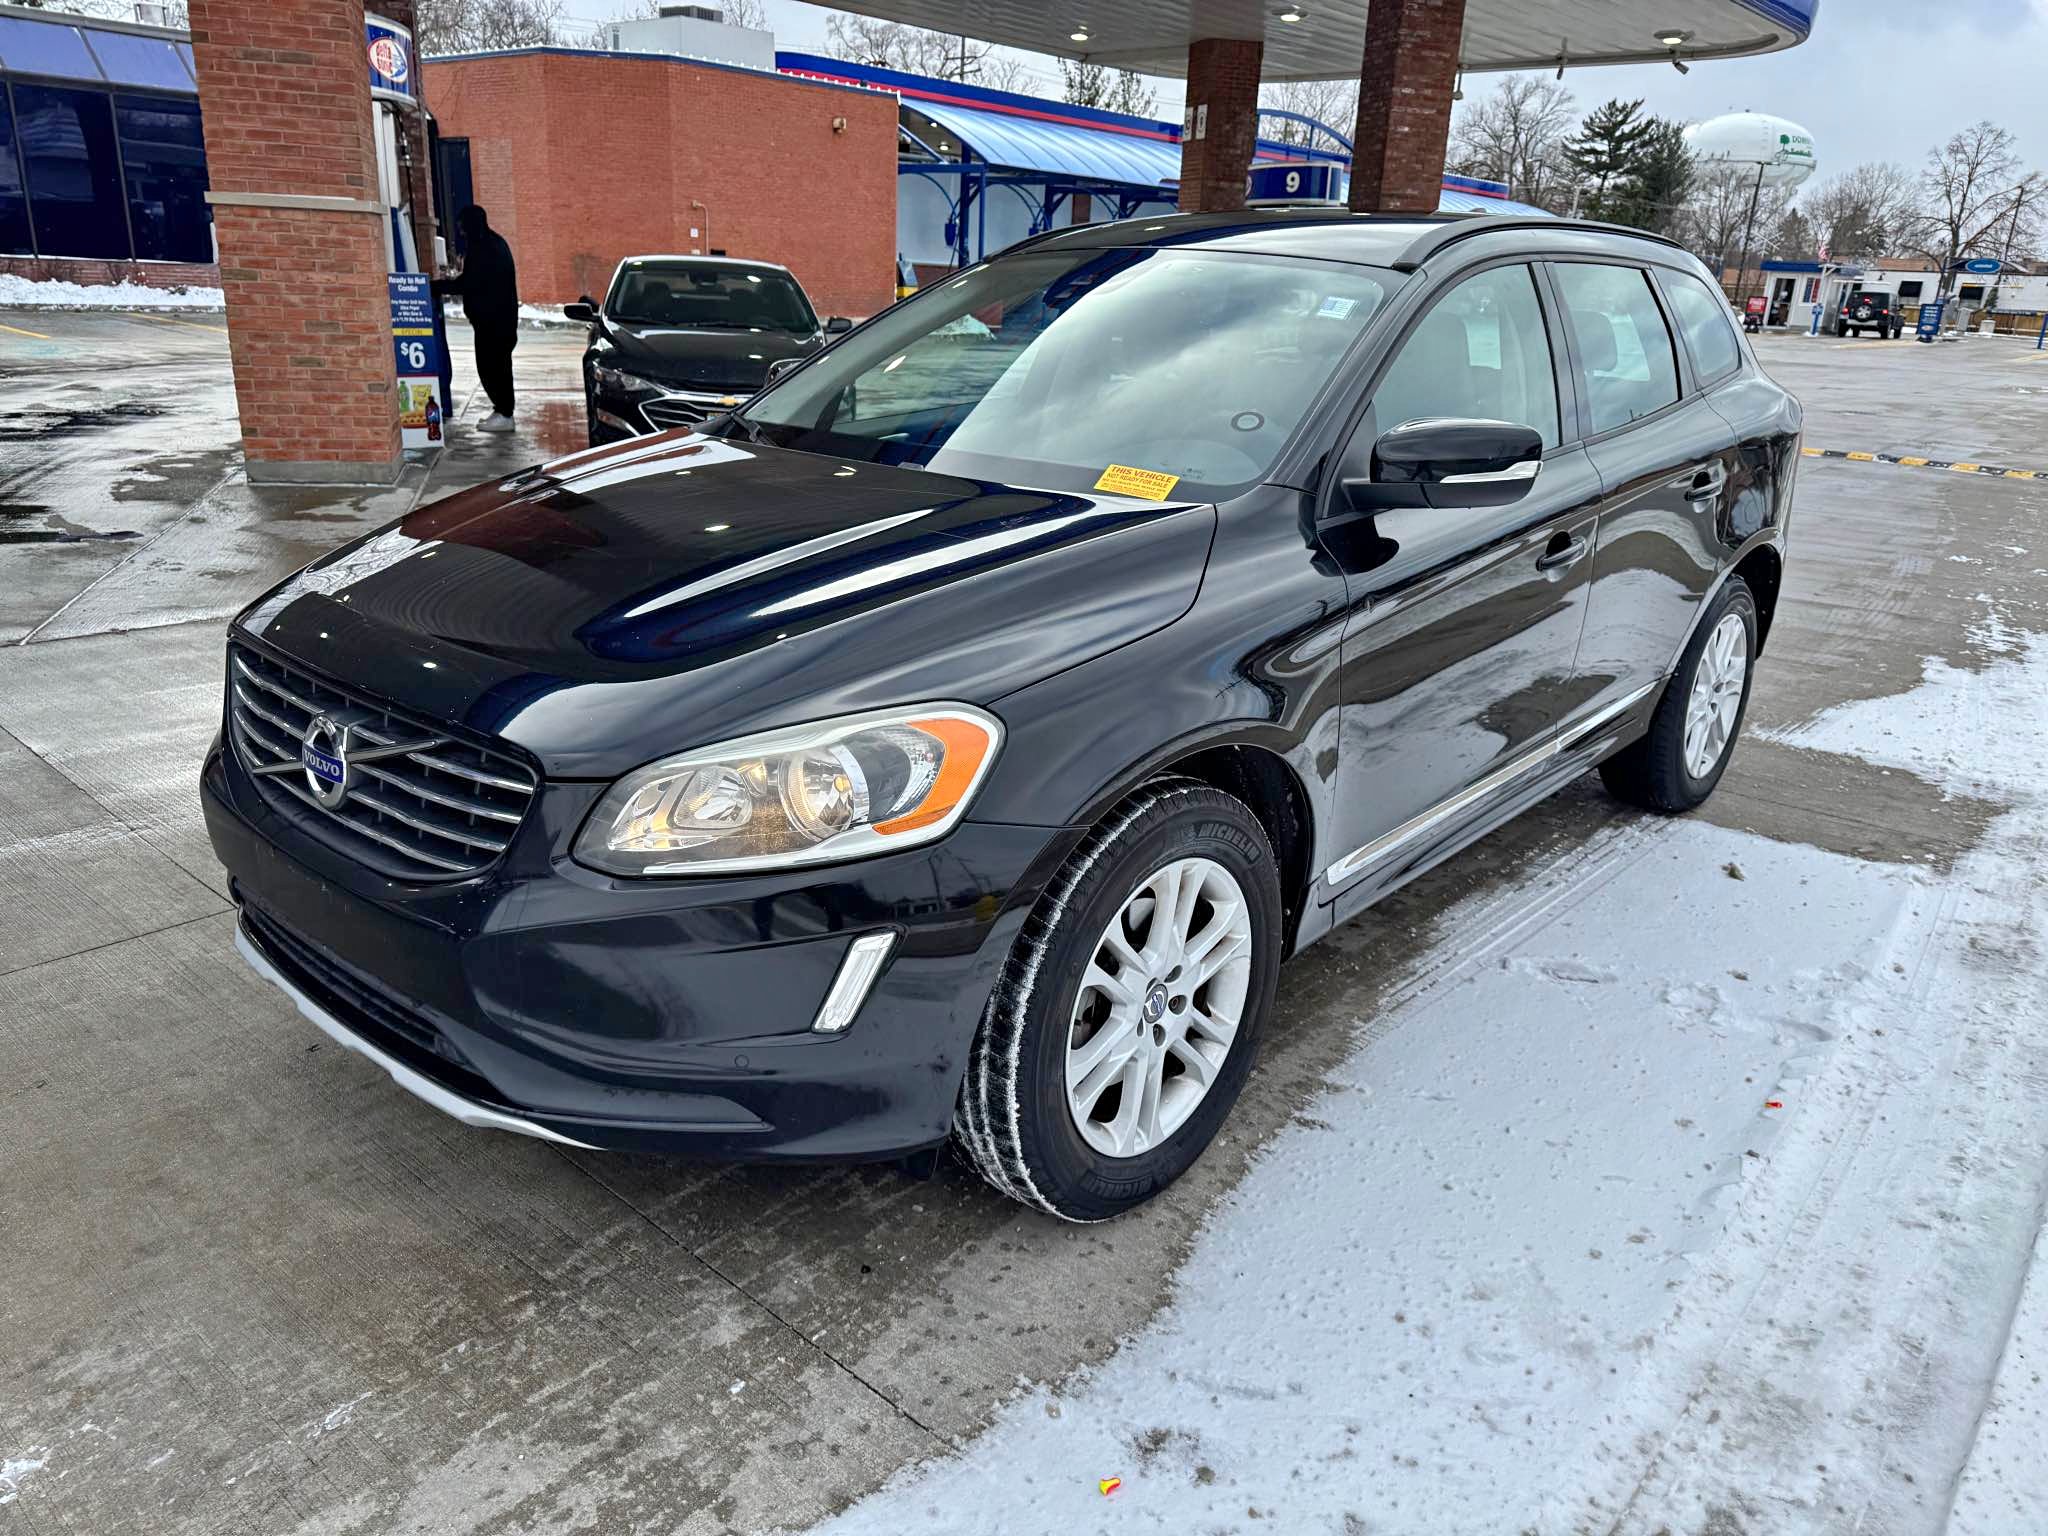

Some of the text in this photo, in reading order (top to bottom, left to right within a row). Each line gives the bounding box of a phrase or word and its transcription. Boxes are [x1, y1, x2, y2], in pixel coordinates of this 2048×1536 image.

[1285, 171, 1300, 193] 9
[400, 342, 425, 369] $6
[1106, 472, 1119, 480] NOT
[1120, 474, 1139, 482] READY
[1111, 466, 1175, 484] THIS VEHICLE
[303, 749, 340, 777] VOLVO
[1198, 822, 1261, 861] MICHELIN
